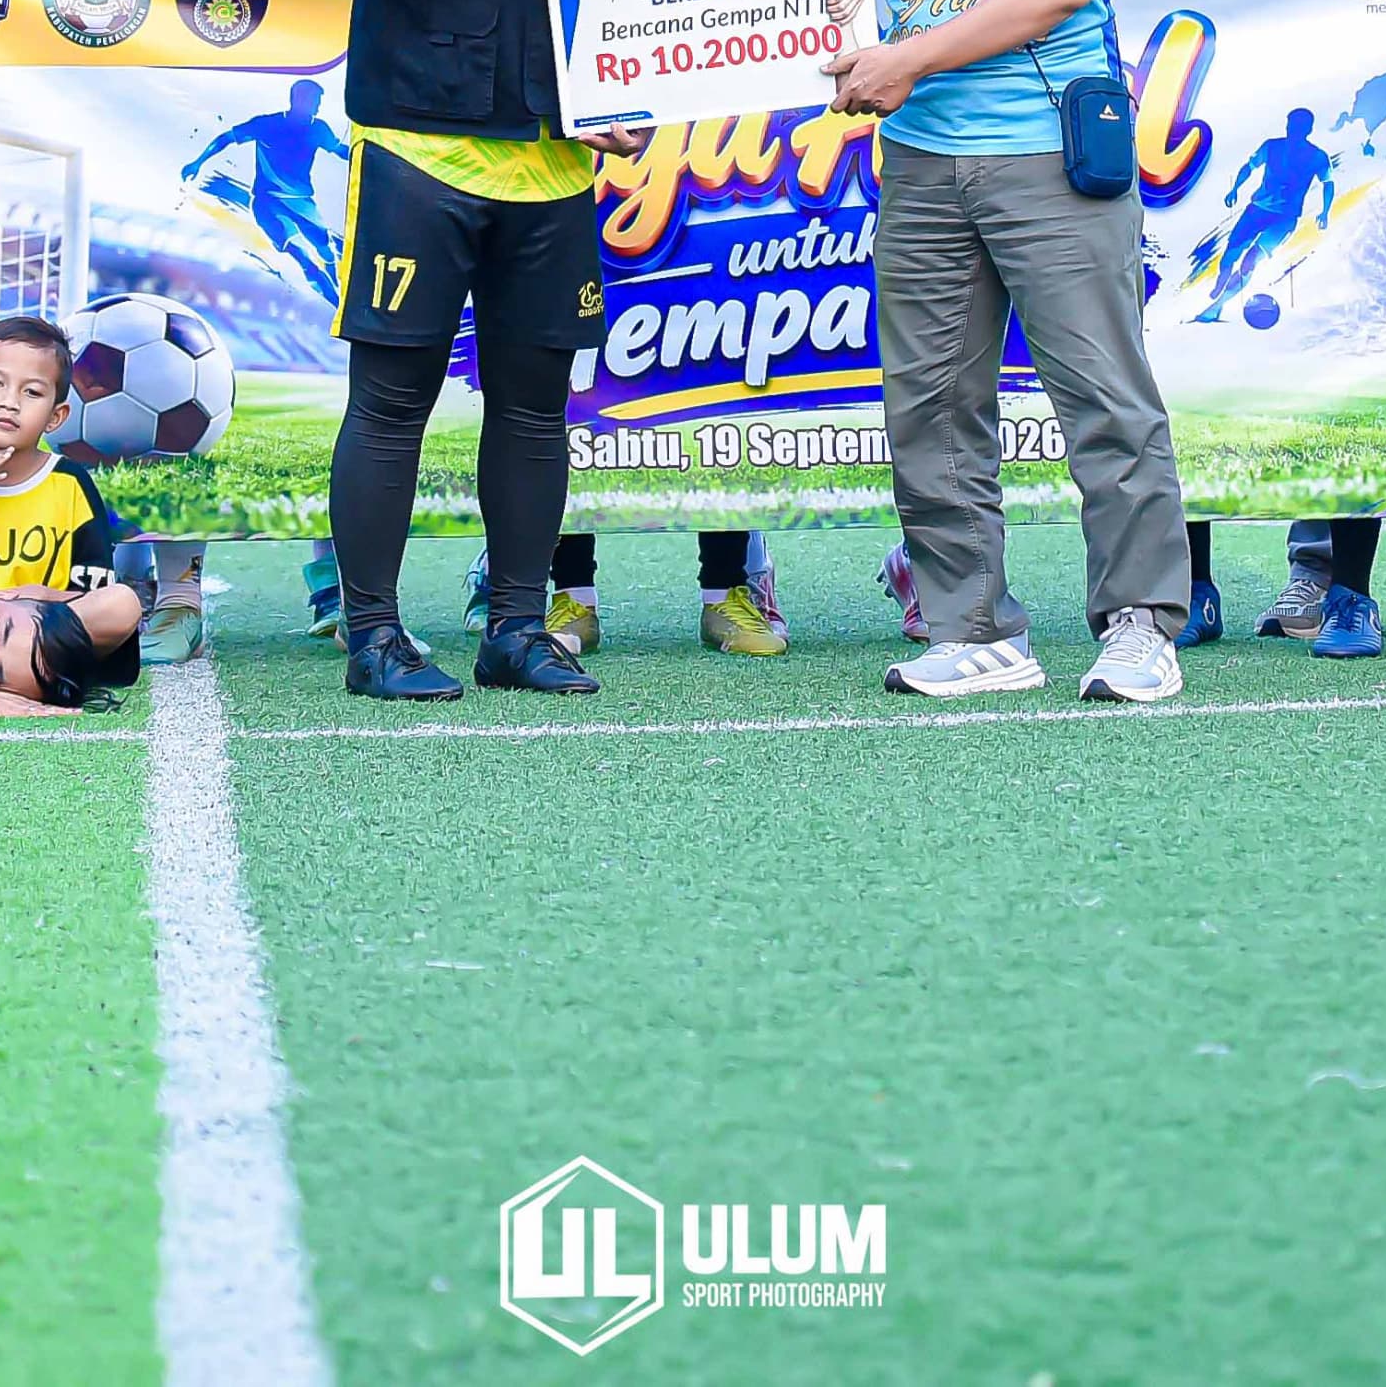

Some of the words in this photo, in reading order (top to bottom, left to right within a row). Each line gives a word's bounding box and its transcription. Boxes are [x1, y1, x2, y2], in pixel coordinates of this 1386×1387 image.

[601, 14, 694, 42] Bencana
[700, 5, 776, 30] Gempa
[595, 53, 641, 86] Rp
[651, 23, 842, 76] 10.200.000
[371, 253, 417, 311] 17
[568, 425, 690, 471] Sabtu,
[695, 424, 742, 471] 19
[998, 417, 1068, 462] 026
